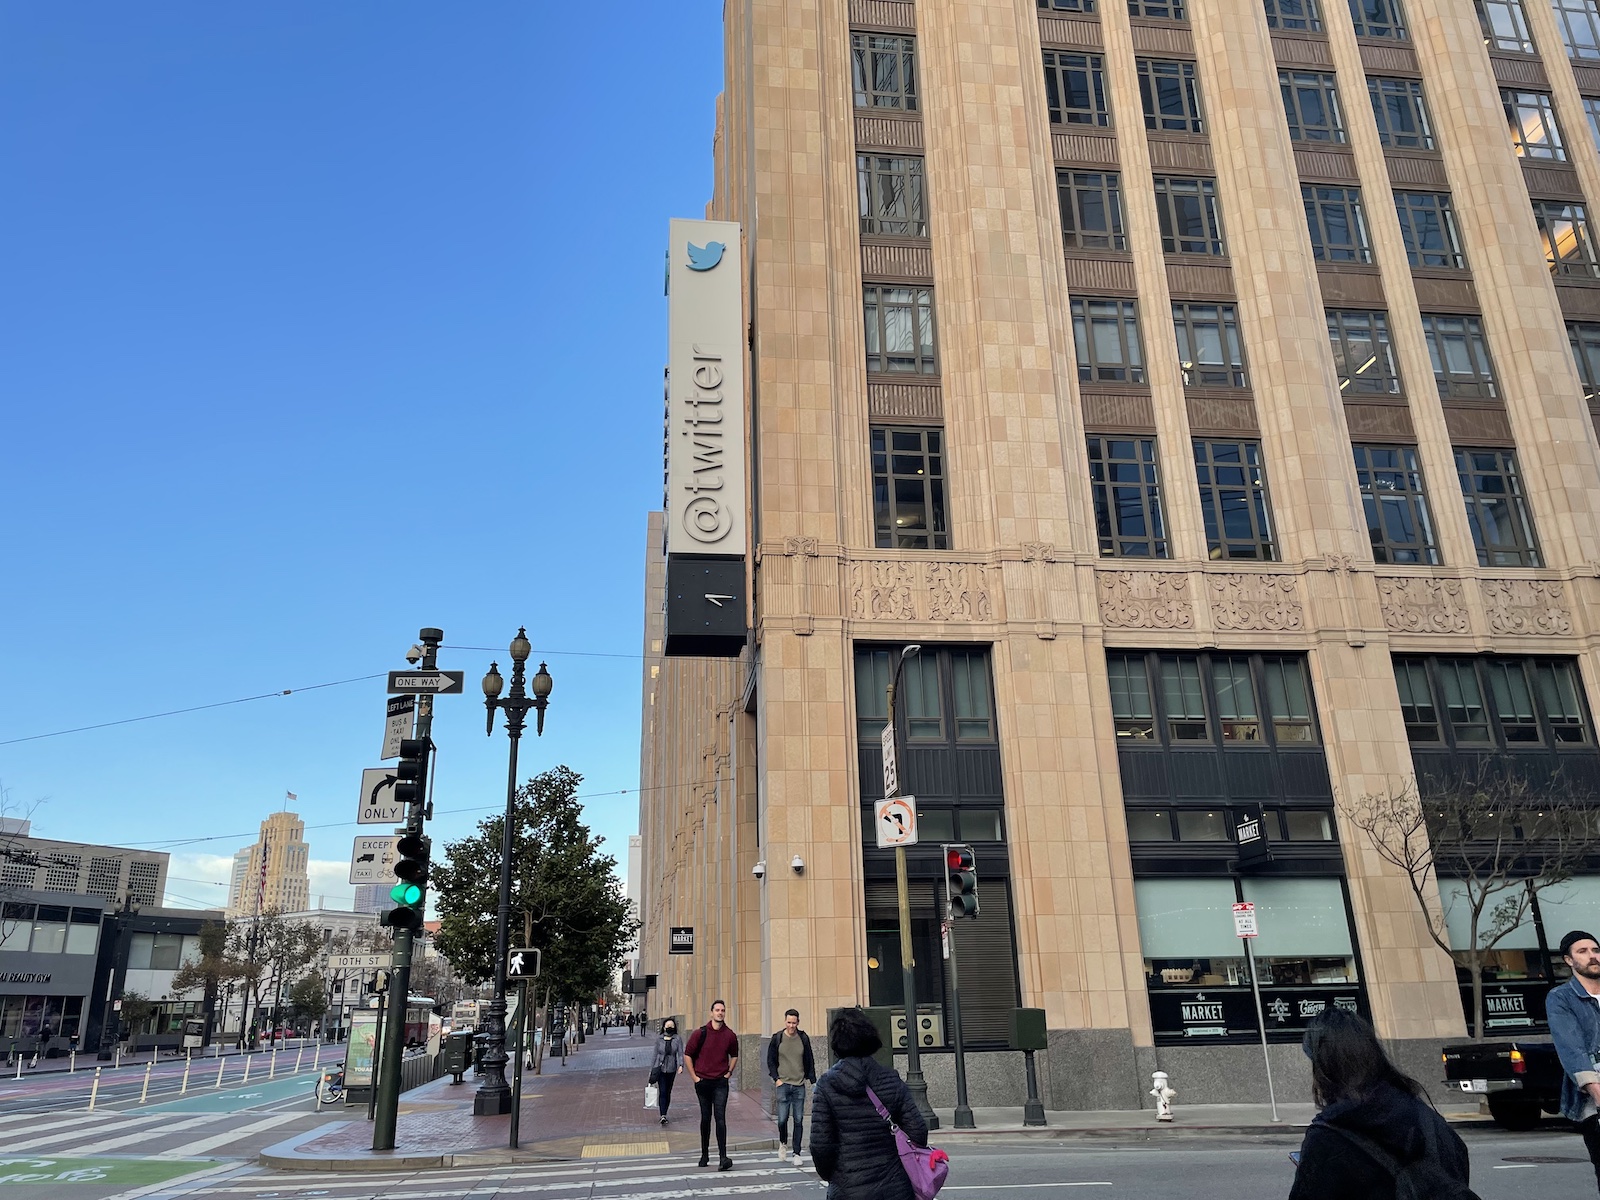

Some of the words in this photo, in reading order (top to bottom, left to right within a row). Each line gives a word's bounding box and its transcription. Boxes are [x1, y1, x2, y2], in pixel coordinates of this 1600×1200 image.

[682, 343, 734, 543] @twitter
[397, 678, 417, 687] ONE
[421, 678, 441, 687] WAY
[388, 702, 400, 713] LEFT
[400, 699, 414, 710] LANE
[391, 718, 402, 728] BUS
[403, 717, 408, 725] &
[393, 727, 405, 736] TAXI
[885, 761, 895, 789] 25
[364, 807, 398, 819] ONLY
[1237, 822, 1260, 842] MARKET
[362, 841, 393, 849] EXCEPT
[672, 935, 692, 943] MARKET
[338, 957, 361, 966] 10TH
[368, 956, 380, 965] ST
[1486, 997, 1525, 1012] MARKET
[1181, 1005, 1223, 1020] MARKET
